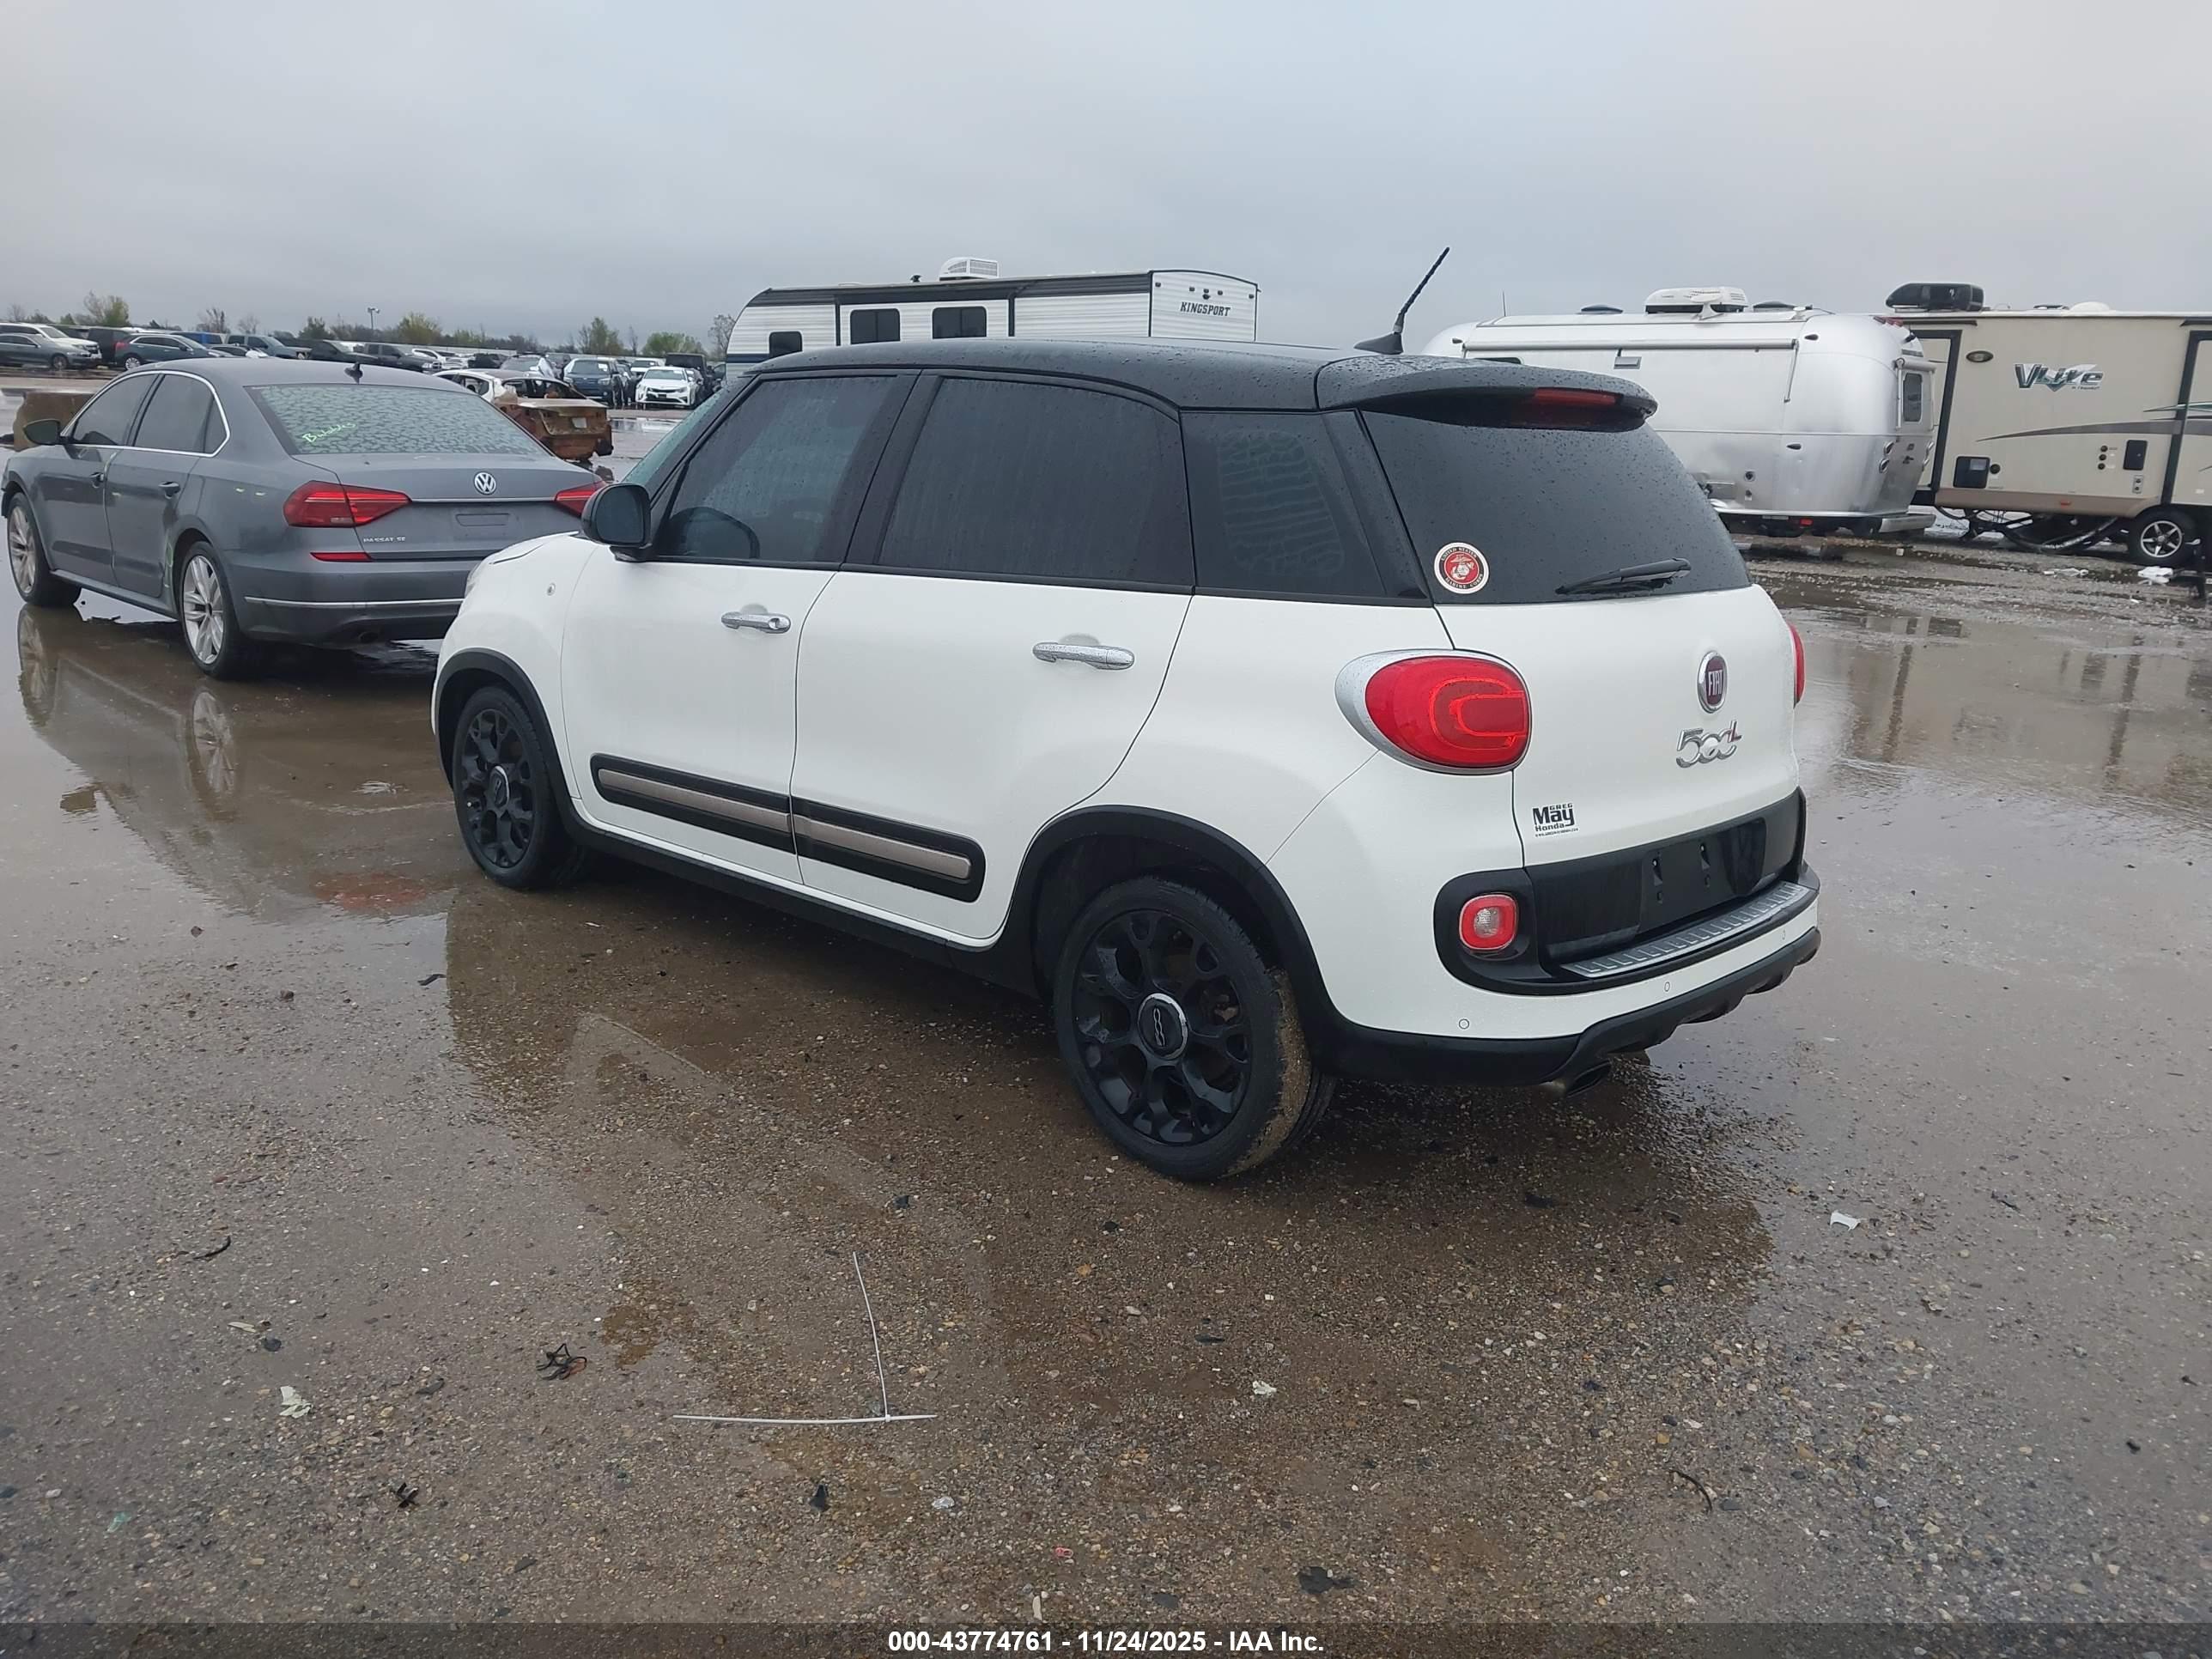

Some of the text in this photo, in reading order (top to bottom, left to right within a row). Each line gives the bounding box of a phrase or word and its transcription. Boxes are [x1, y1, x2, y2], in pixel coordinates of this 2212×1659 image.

[1180, 301, 1231, 317] KINGSPORT
[1445, 576, 1468, 590] MARINE
[1708, 669, 1723, 696] FIAT
[1549, 802, 1573, 811] GREG
[1532, 806, 1576, 827] May
[1534, 822, 1565, 832] Honda
